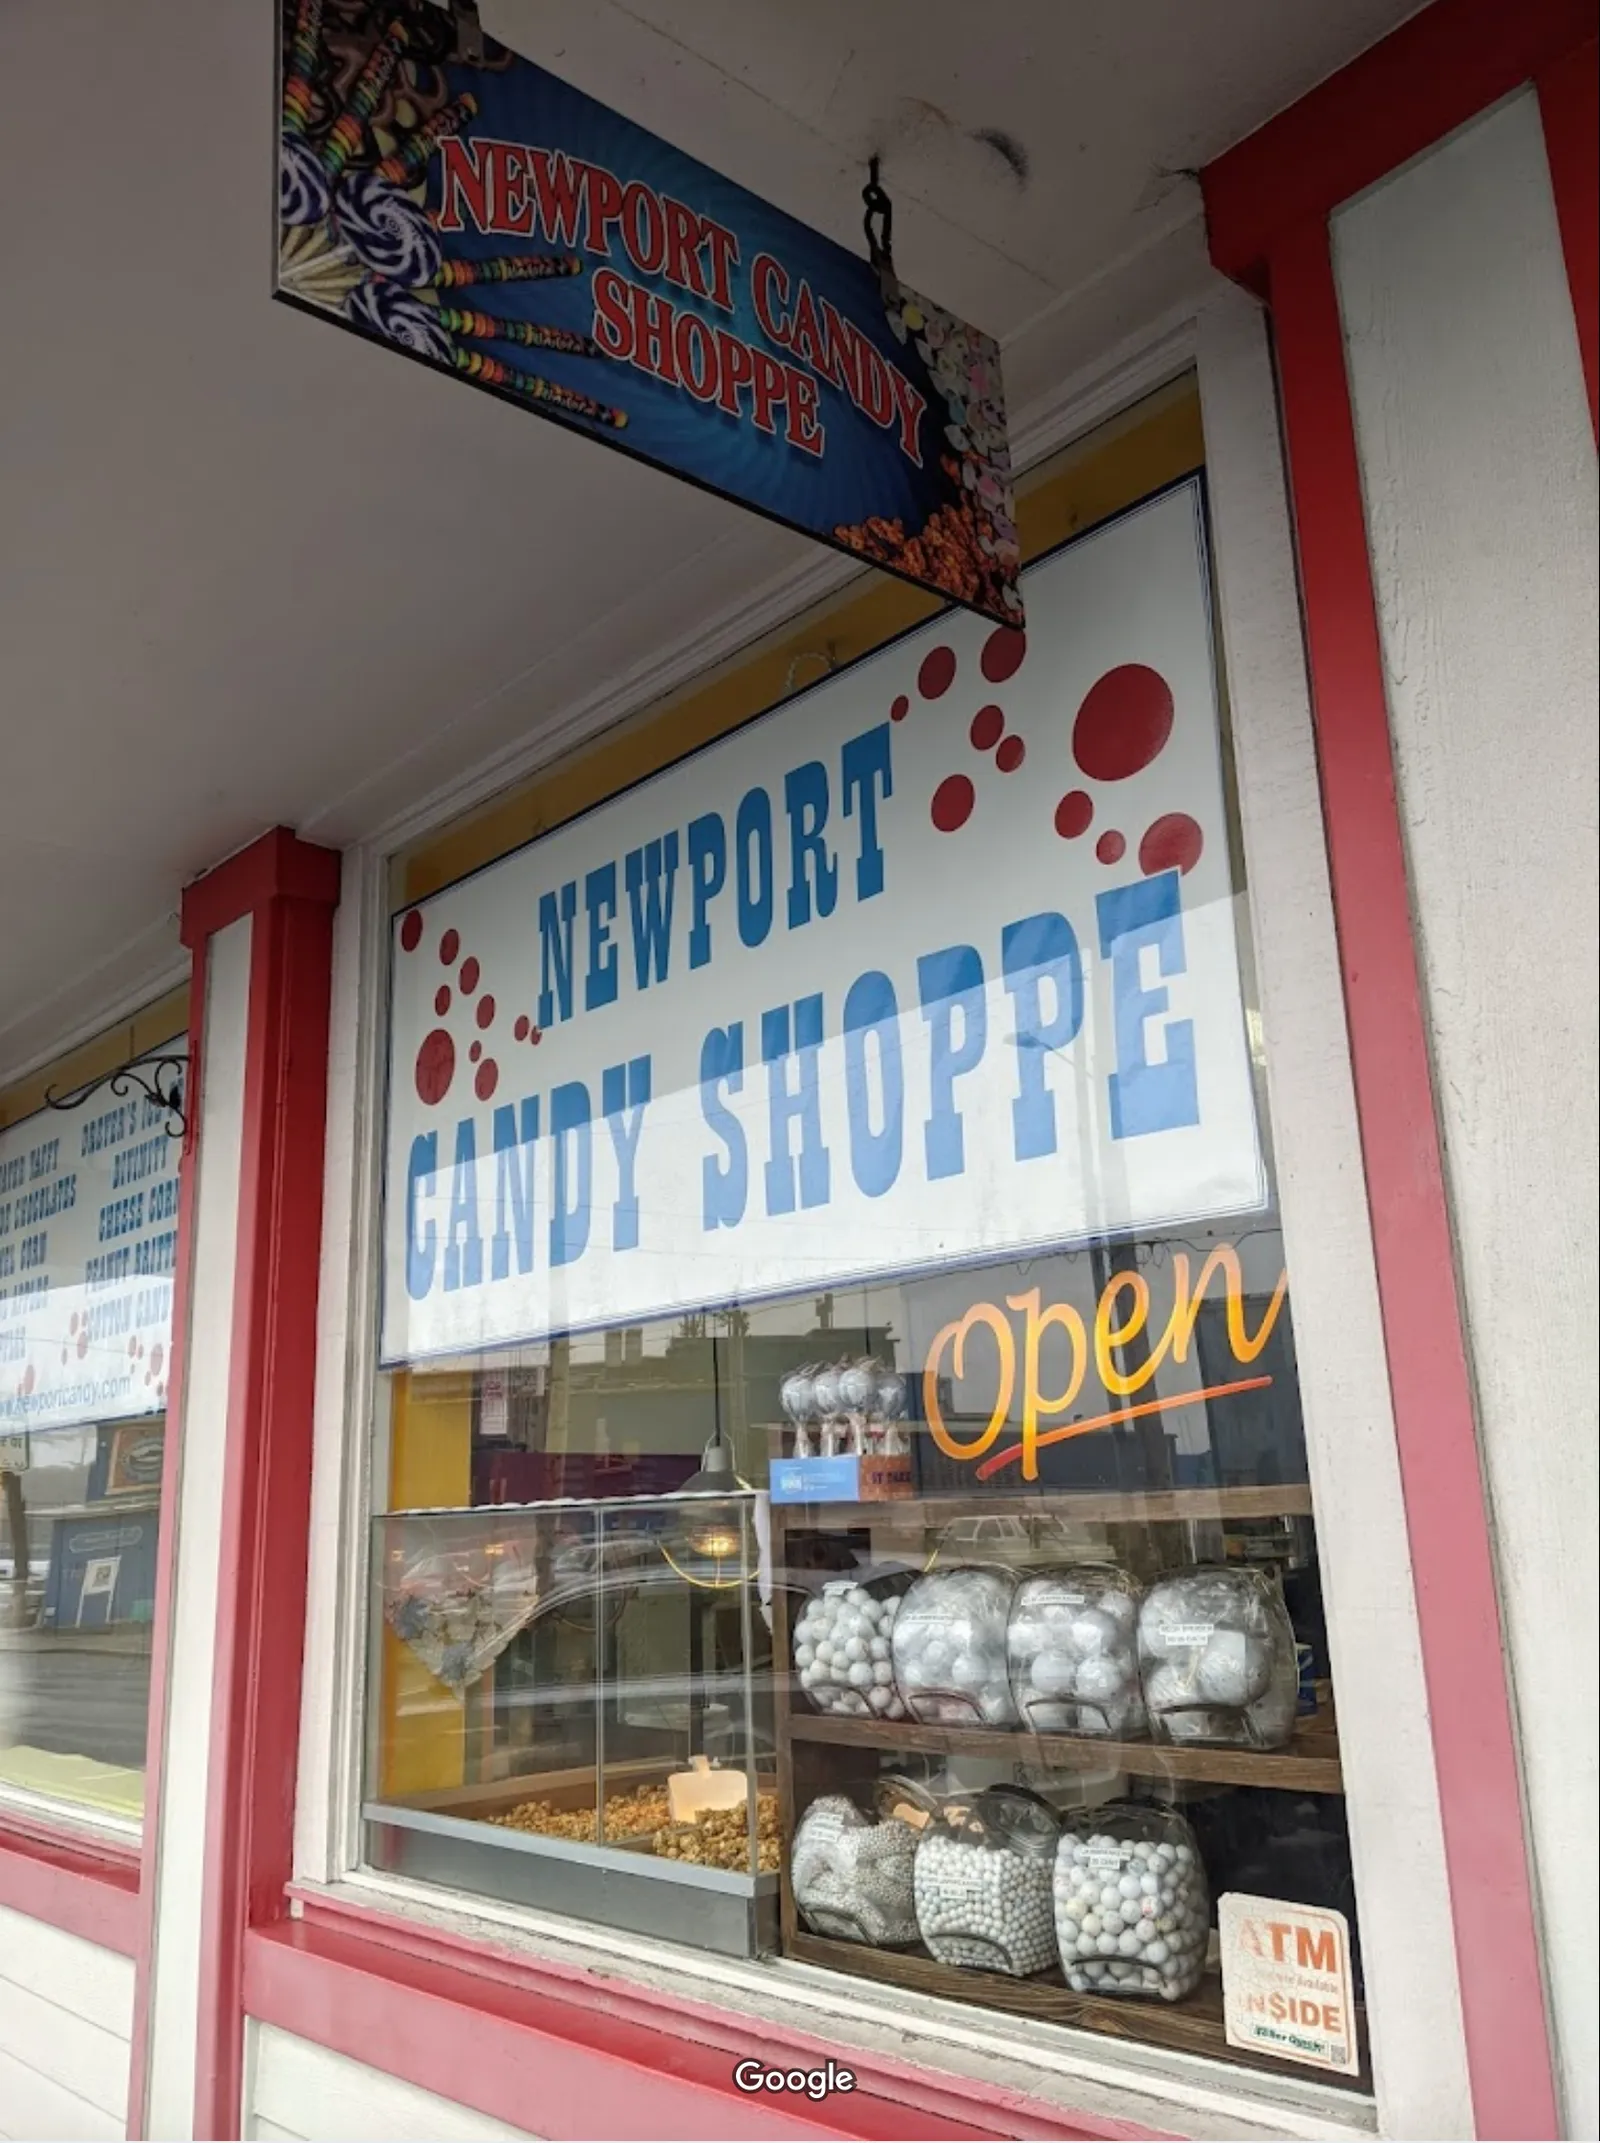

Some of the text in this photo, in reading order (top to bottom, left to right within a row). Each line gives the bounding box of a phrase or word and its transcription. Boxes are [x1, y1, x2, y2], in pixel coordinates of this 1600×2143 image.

[436, 135, 928, 468] NEWPORT CANDY
[591, 267, 824, 457] SHOPPE
[537, 721, 895, 1032] NEWPORT
[405, 868, 1201, 1302] CANDY SHOPPE
[923, 1243, 1289, 1481] Open
[1238, 1918, 1337, 1974] ATM
